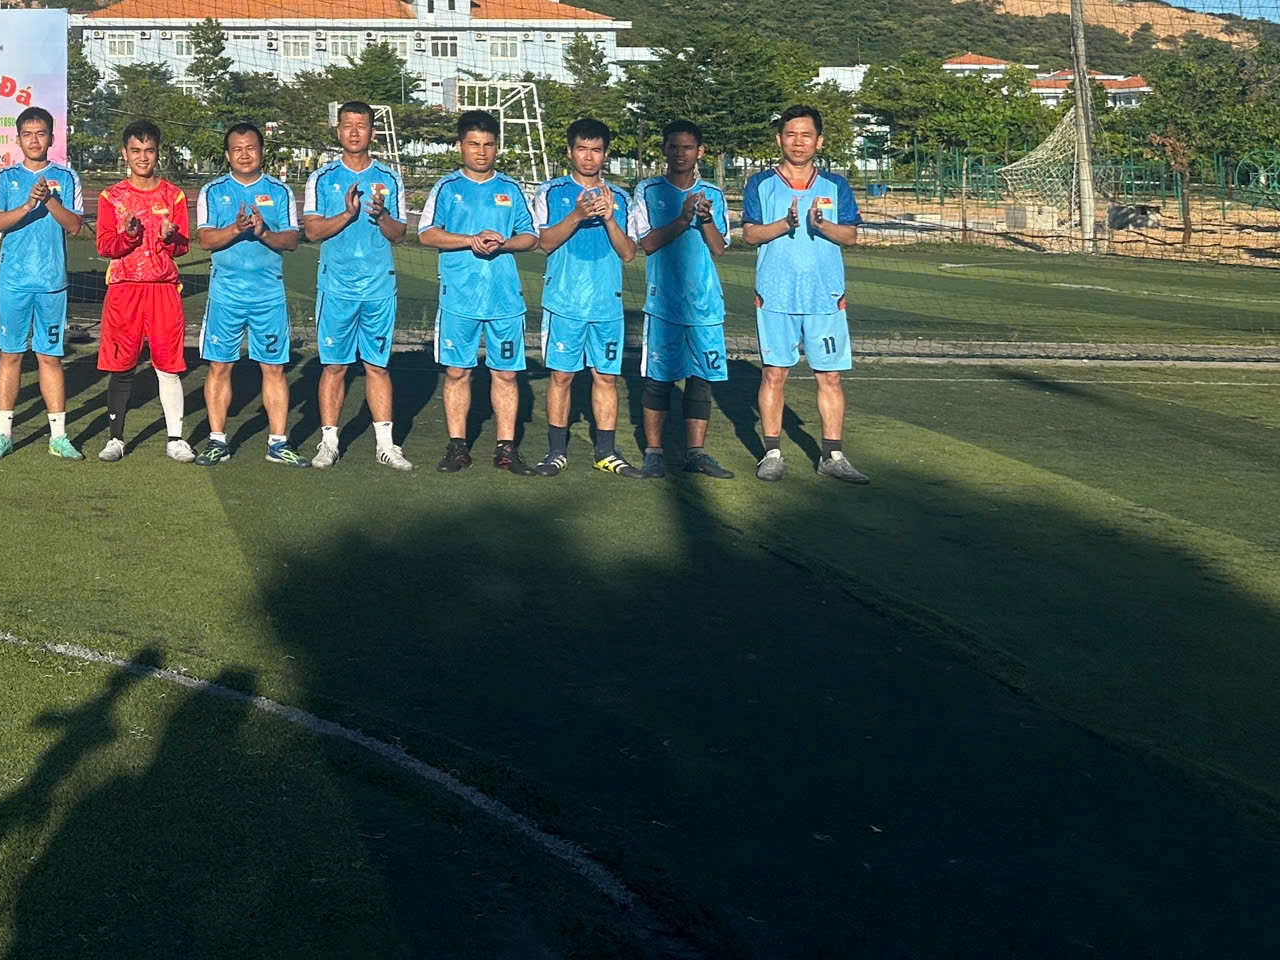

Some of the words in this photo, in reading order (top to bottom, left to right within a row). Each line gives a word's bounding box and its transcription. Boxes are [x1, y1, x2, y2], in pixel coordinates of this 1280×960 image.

[47, 324, 60, 345] 5
[264, 334, 278, 354] 2
[113, 342, 119, 360] 1
[375, 335, 387, 355] 7
[500, 340, 514, 360] 8
[605, 341, 618, 361] 6
[822, 336, 837, 355] 11
[702, 350, 721, 370] 12
